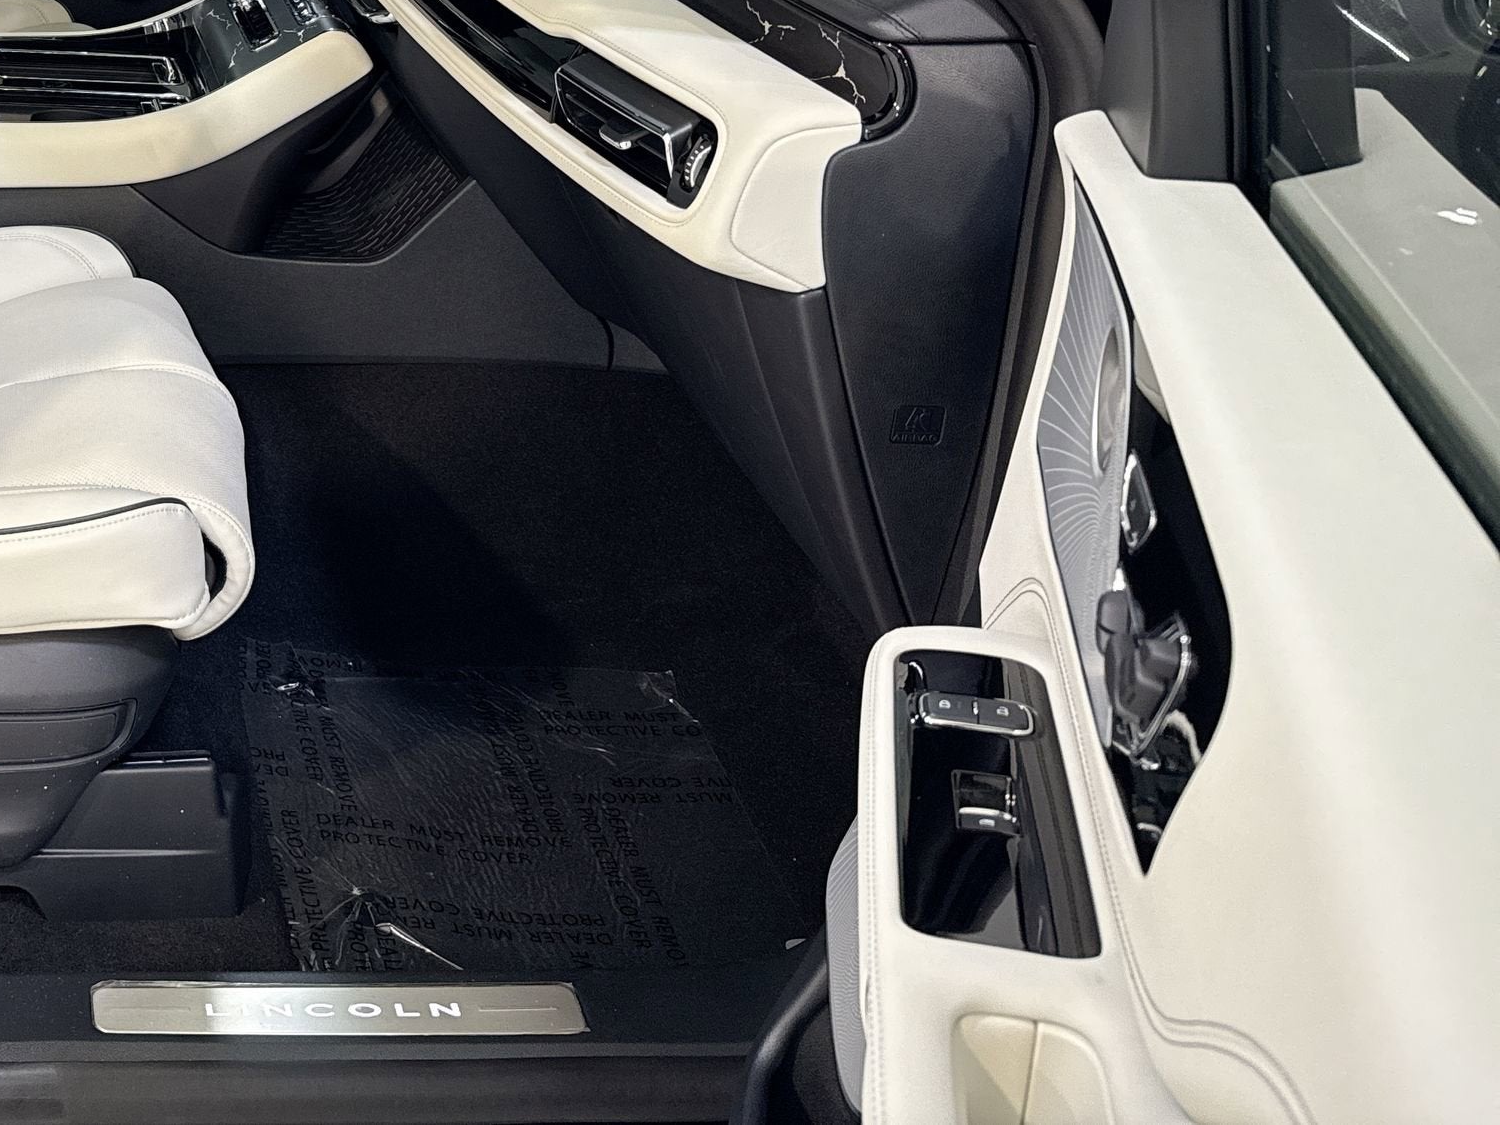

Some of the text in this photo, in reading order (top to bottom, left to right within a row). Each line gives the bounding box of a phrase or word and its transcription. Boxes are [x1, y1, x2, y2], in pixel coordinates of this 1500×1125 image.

[624, 711, 679, 722] MUST
[544, 725, 662, 738] PROTECTIVE
[609, 777, 682, 788] COVER
[573, 792, 732, 804] MUST REMOVE
[316, 812, 573, 849] DEALER MUST REMOVE
[320, 829, 533, 865] PROTECTIVE COVER
[471, 906, 606, 926] PROTECTIVE
[615, 895, 652, 949] COVER
[453, 922, 513, 941] MUST
[526, 930, 613, 946] DEALER
[204, 1001, 462, 1018] LINCOLN
